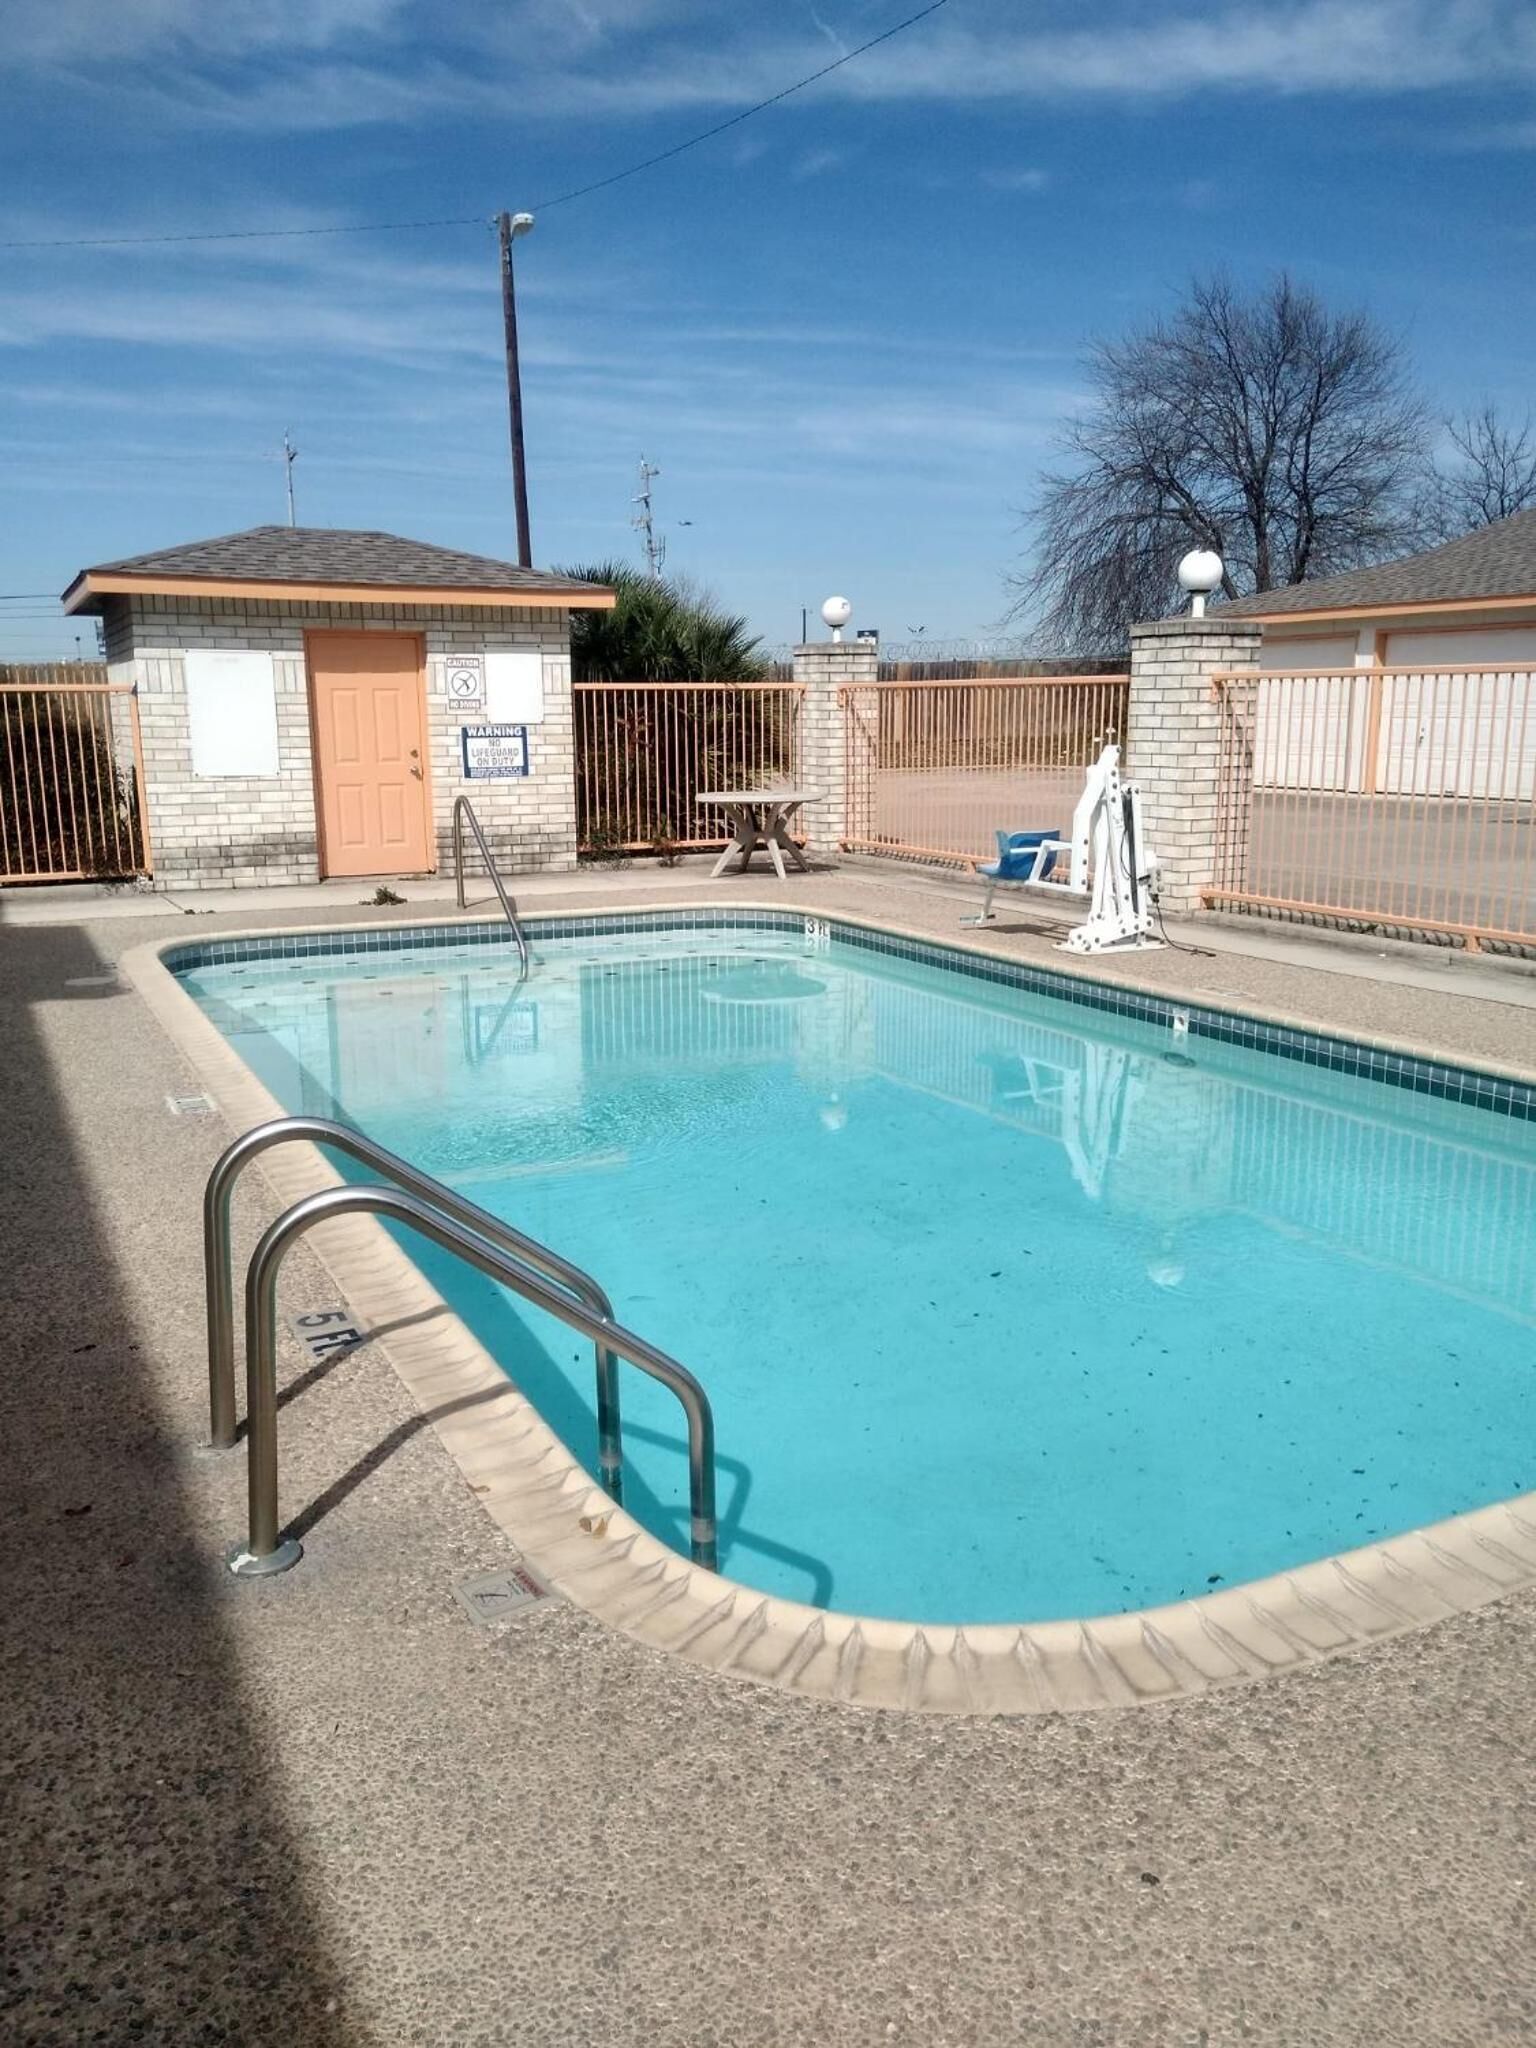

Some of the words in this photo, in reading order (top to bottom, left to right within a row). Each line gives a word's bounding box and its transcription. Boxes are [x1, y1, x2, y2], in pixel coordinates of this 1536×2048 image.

[467, 726, 522, 736] WARNING
[488, 738, 501, 747] NO
[471, 747, 519, 757] LIFEGUARD
[477, 757, 490, 766] ON
[491, 757, 514, 766] DUTY
[807, 917, 816, 934] 3
[296, 1311, 348, 1327] 5
